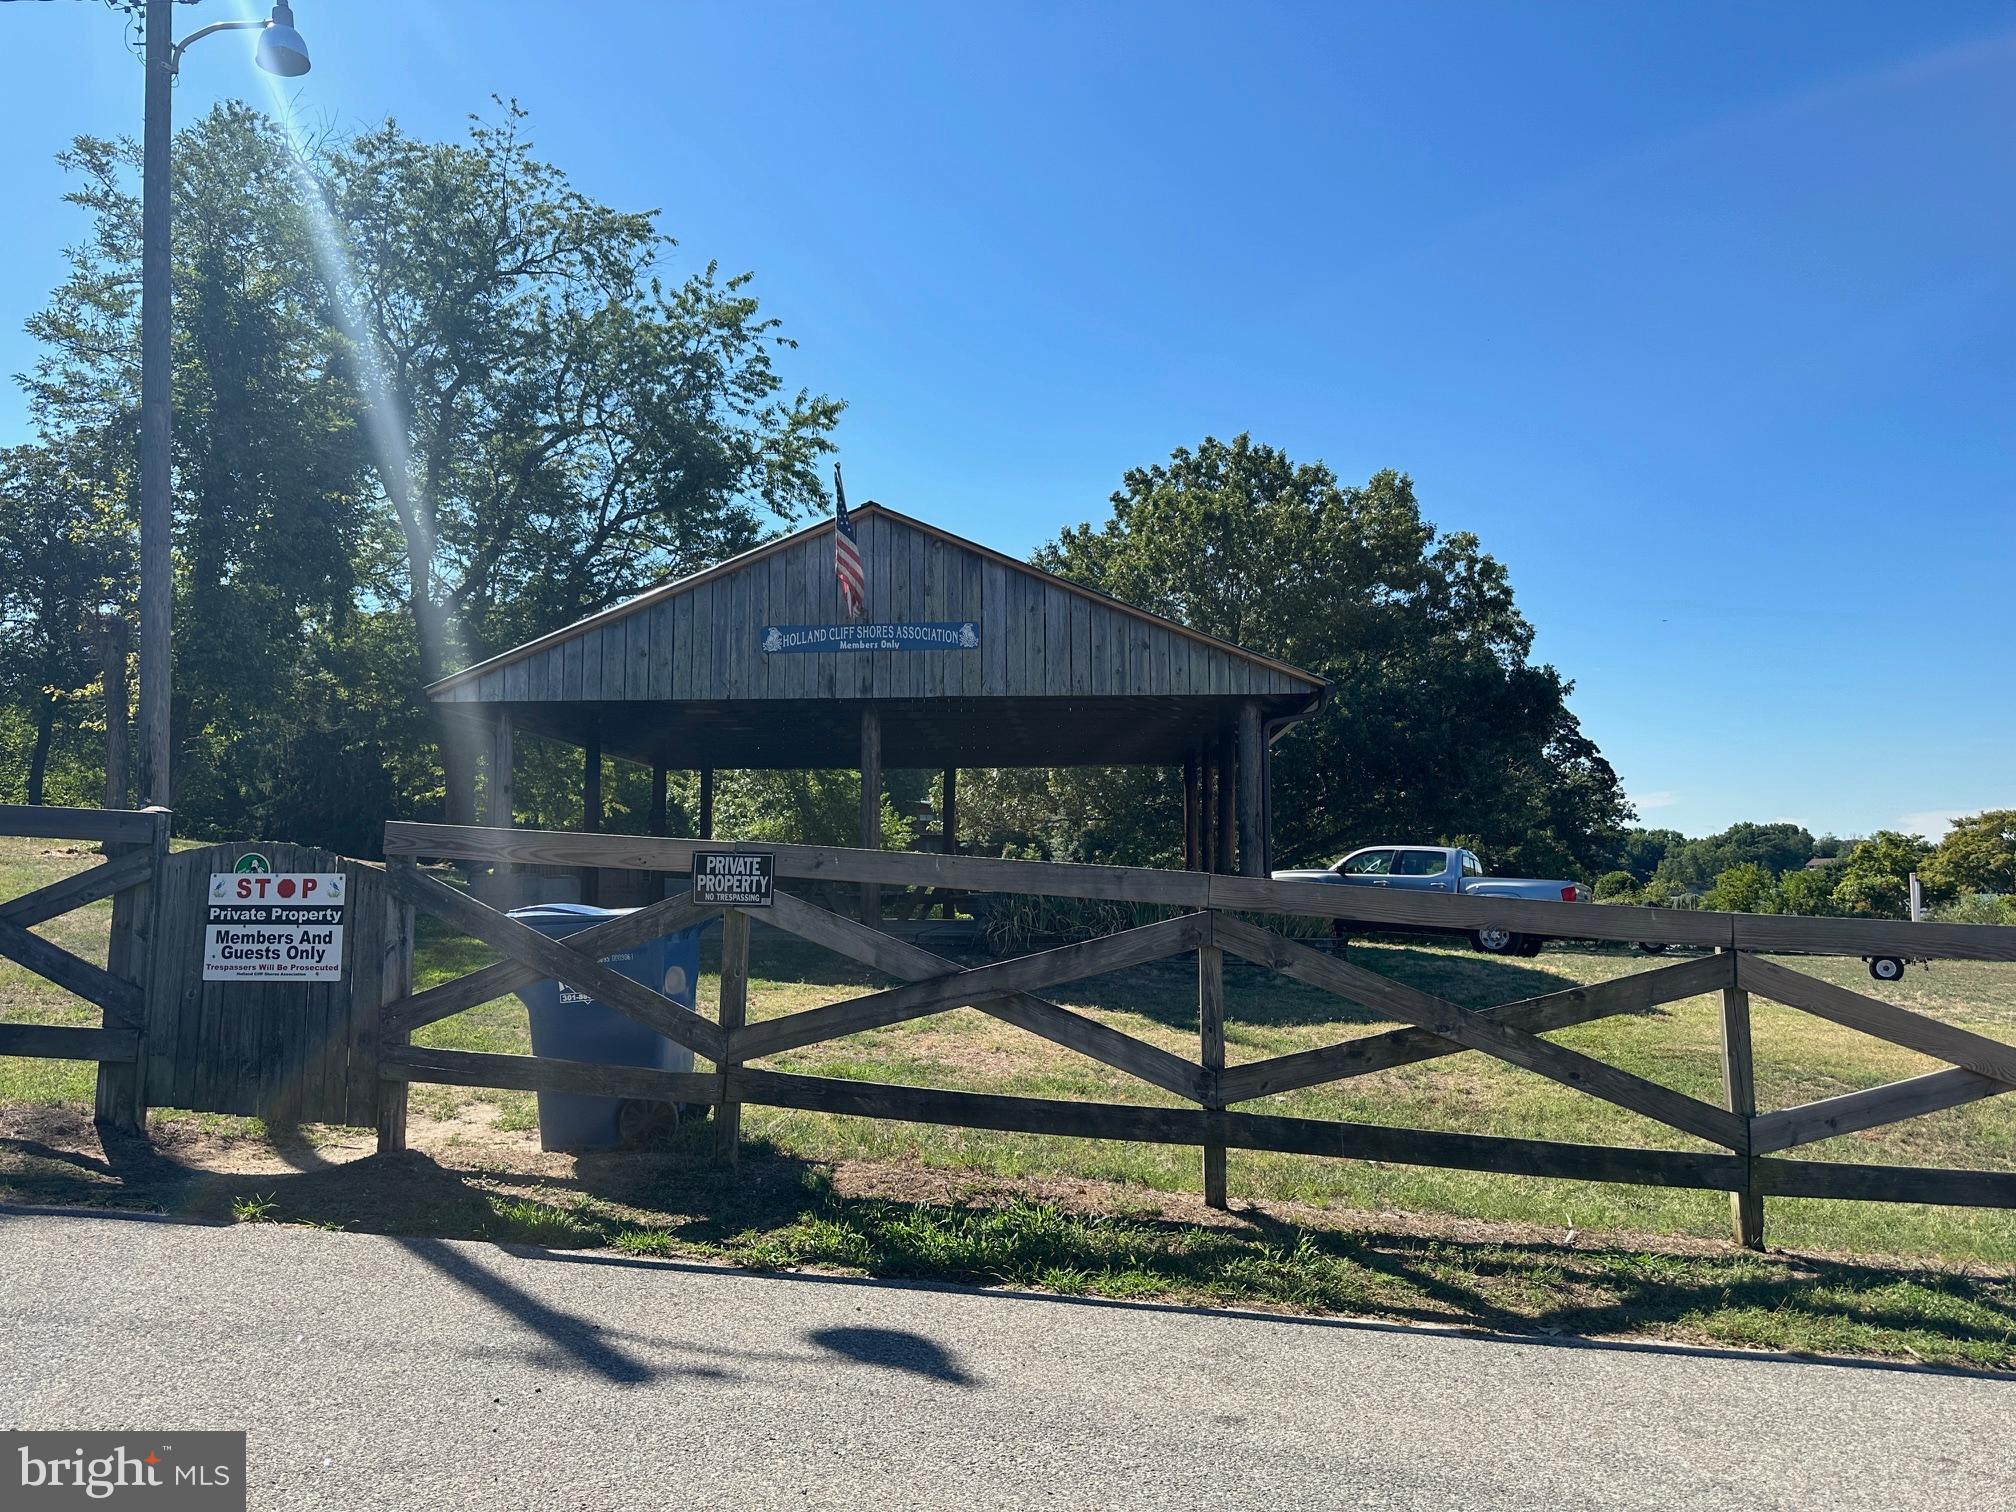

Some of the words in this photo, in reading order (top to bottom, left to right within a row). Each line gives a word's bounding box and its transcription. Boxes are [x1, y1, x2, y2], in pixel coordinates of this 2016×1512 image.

[782, 629, 827, 647] HOLLAND
[828, 626, 855, 640] CLIFF
[856, 625, 894, 638] SHORES
[895, 625, 960, 644] ASSOCIATION
[839, 640, 879, 650] Members
[880, 639, 900, 650] Only
[706, 856, 761, 875] PRIVATE
[697, 874, 769, 893] PROPERTY
[705, 893, 715, 901] NO
[717, 893, 760, 902] TRESPASSING
[209, 907, 267, 920] Private
[271, 908, 342, 923] Property
[215, 930, 294, 945] Members
[299, 930, 333, 945] And
[221, 945, 281, 960] Guests
[286, 945, 326, 963] Only
[206, 963, 257, 972] Trespassers
[259, 963, 275, 971] Will
[277, 963, 288, 971] Be
[290, 963, 339, 971] Prosecuted
